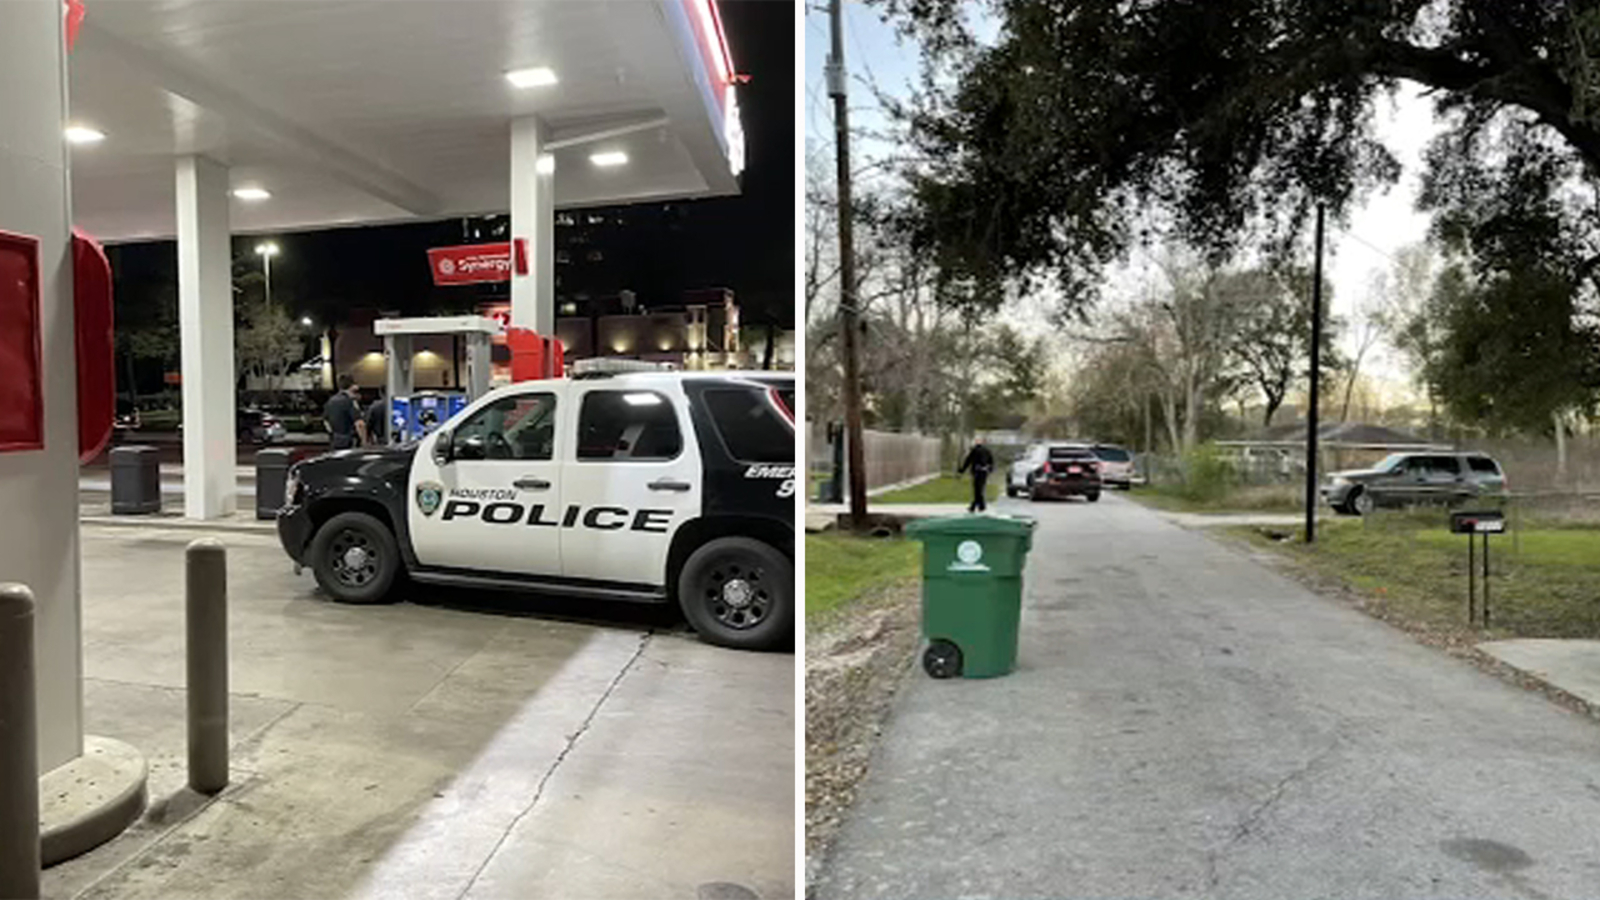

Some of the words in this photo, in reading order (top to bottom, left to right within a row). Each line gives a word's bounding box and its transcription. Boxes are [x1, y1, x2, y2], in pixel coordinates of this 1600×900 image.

[449, 488, 517, 501] HOUSTON
[776, 479, 795, 497] 9
[441, 500, 674, 533] POLICE
